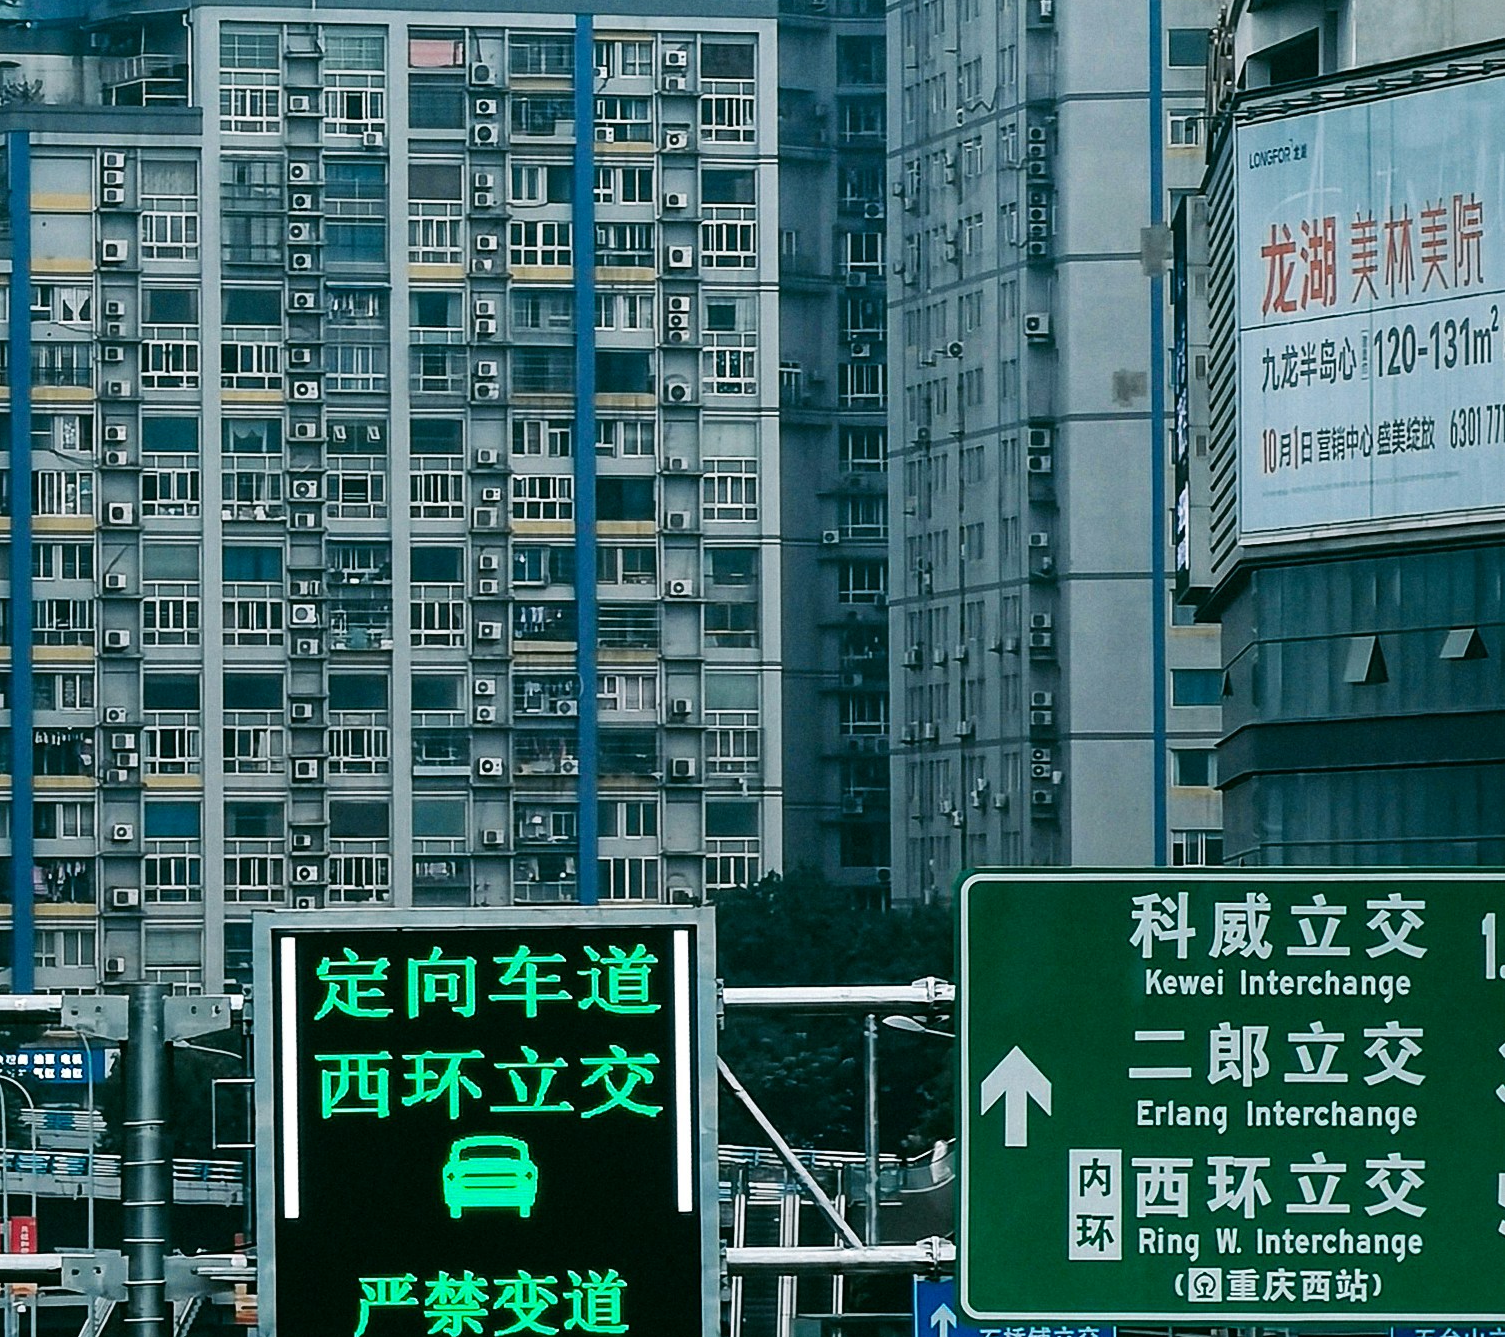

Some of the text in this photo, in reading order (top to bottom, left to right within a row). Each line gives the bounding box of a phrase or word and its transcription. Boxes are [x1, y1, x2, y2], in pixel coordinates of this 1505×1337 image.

[1248, 146, 1291, 170] LONGFOR
[1260, 192, 1485, 318] 龙湖 美林美院
[1261, 337, 1357, 394] 九龙半岛心
[1262, 425, 1313, 474] 10月1日
[1317, 424, 1374, 464] 营销中心
[1377, 416, 1436, 456] 盛美绽放
[1128, 891, 1429, 961] 科威立交
[313, 944, 662, 1021] 定向车道
[1145, 969, 1412, 1004] Kewei Interchange
[312, 1045, 664, 1121] 西环立交
[1128, 1020, 1427, 1088] 二郎立交
[1137, 1099, 1418, 1135] Erlang Interchange
[1076, 1158, 1115, 1254] 内环
[1132, 1151, 1427, 1219] 西环立交
[1138, 1227, 1424, 1263] Ring W. Interchange
